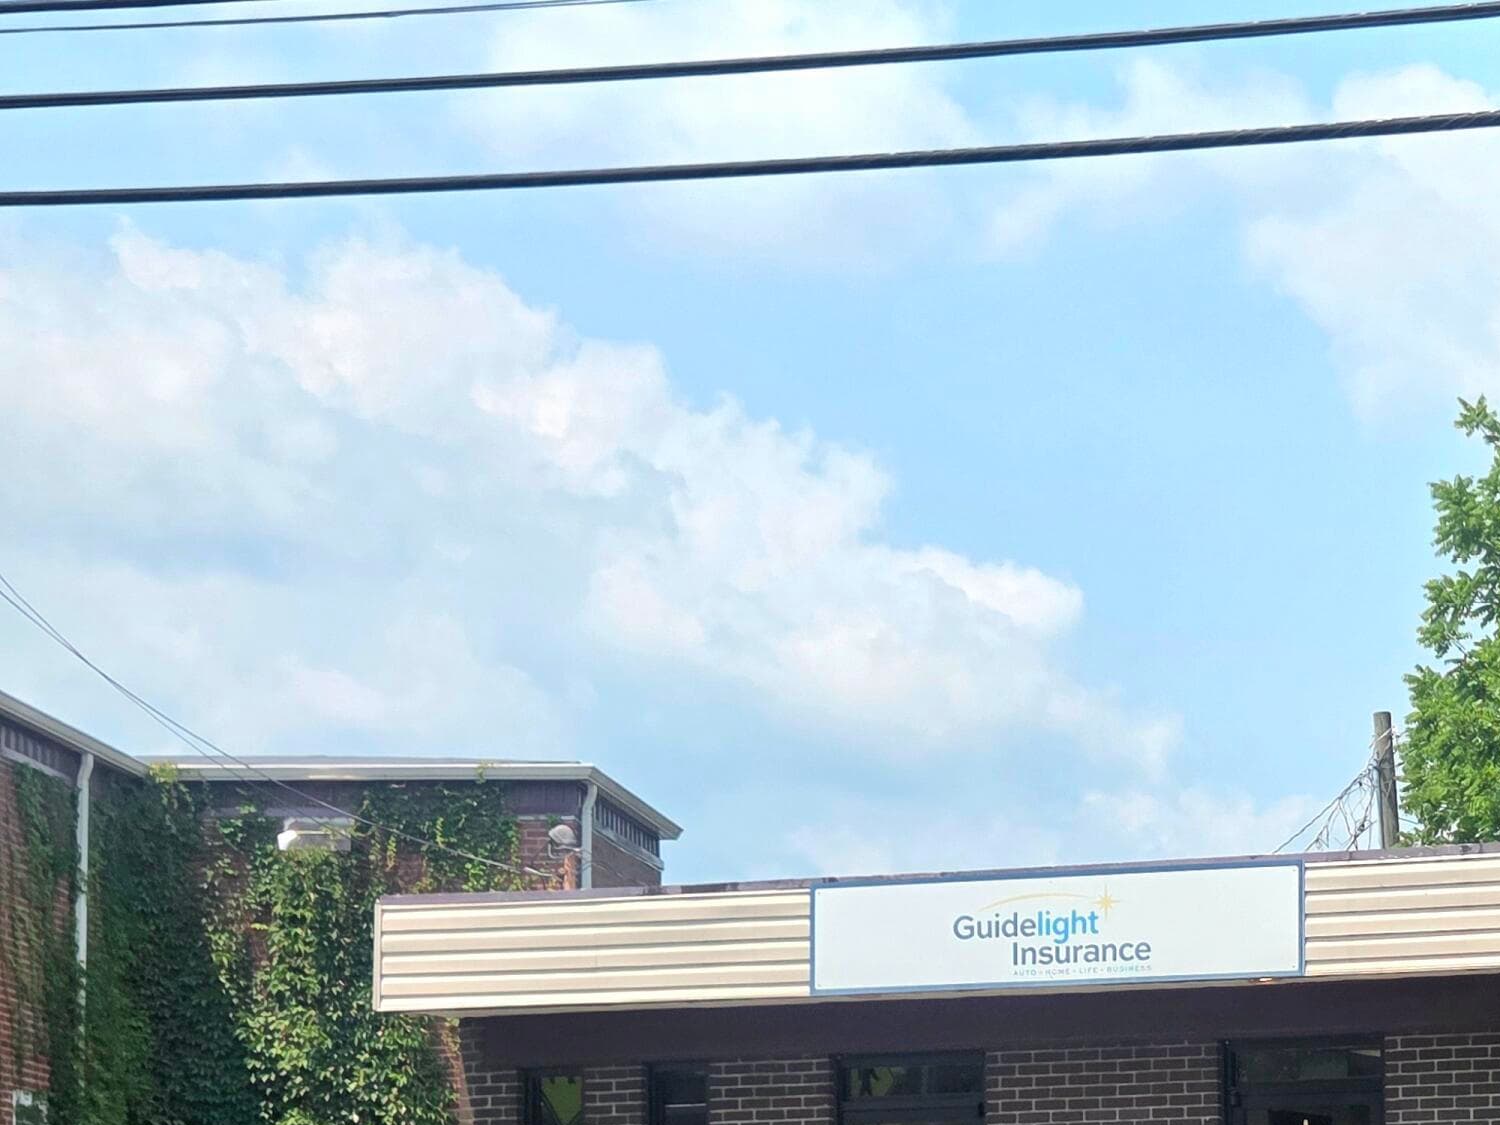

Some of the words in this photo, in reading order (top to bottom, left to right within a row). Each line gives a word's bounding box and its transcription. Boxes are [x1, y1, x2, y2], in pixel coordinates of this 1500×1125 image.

[953, 909, 1099, 944] Guidelight
[1012, 942, 1151, 966] Insurance
[1013, 968, 1037, 977] AUTO
[1079, 965, 1098, 975] LIFE
